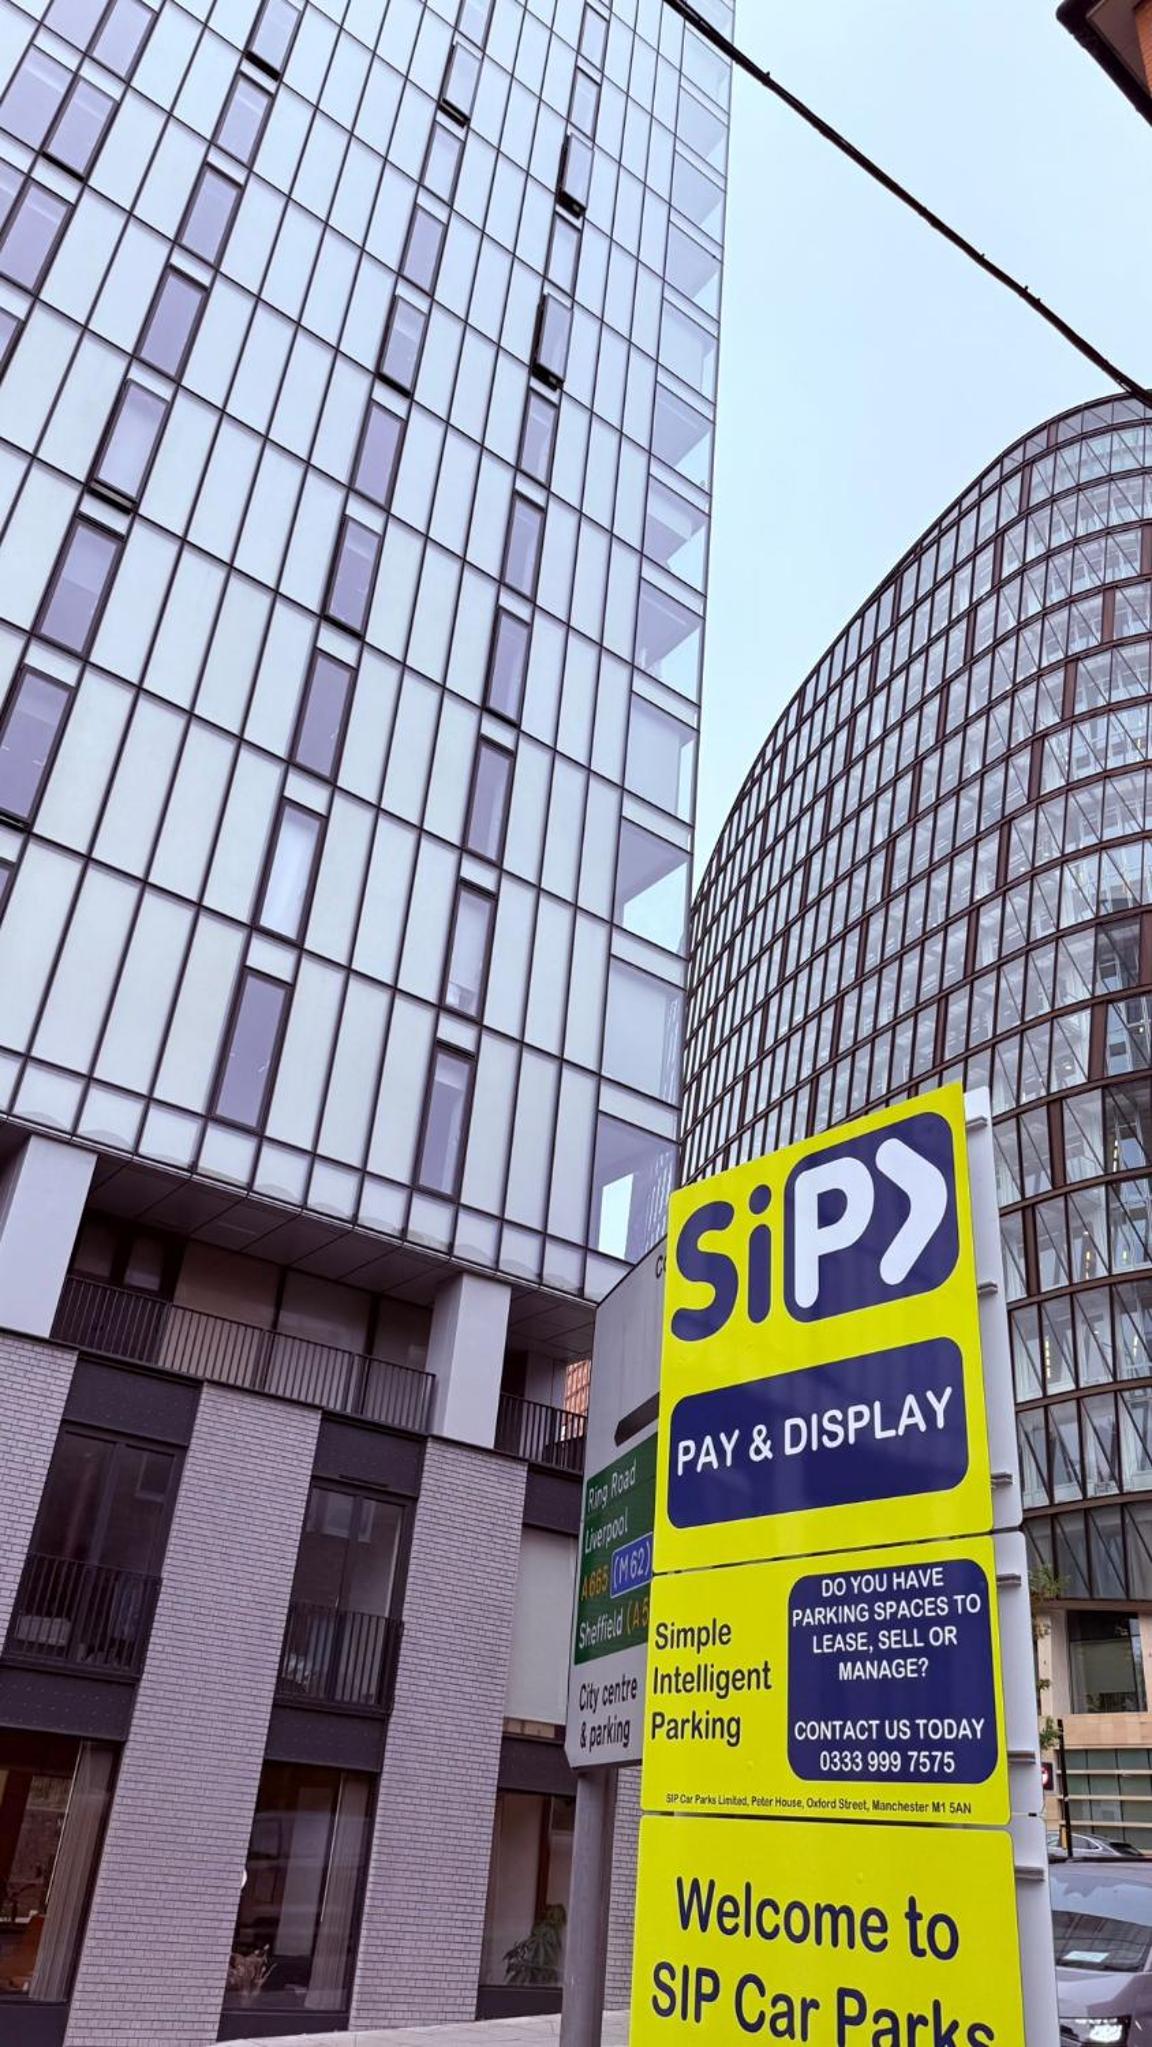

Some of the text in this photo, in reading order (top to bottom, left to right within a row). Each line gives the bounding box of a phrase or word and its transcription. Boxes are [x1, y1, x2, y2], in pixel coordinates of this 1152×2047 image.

[677, 1386, 953, 1477] PAY & DISPLAY
[588, 1457, 636, 1512] Ring Road
[585, 1506, 628, 1553] Liverpool
[613, 1540, 651, 1591] (M62)
[821, 1567, 945, 1598] DO YOU HAVE
[579, 1605, 623, 1648] Sheffield
[792, 1593, 981, 1627] PARKING SPACES TO
[654, 1616, 732, 1655] Simple
[812, 1625, 958, 1654] LEASE, SELL OR
[653, 1660, 772, 1700] Intelligent
[838, 1657, 929, 1681] MANAGE?
[579, 1674, 637, 1714] City centre
[580, 1714, 631, 1752] & parking
[651, 1709, 742, 1748] Parking
[794, 1718, 985, 1741] CONTACT US TODAY
[819, 1750, 955, 1773] 0333 999 7575
[666, 1793, 972, 1814] SIP Car Parks Limited, Peter House, Oxford Street, Manchester M1 5AN
[676, 1876, 960, 1961] Welcome to
[651, 1961, 721, 2024] SIP
[734, 1973, 821, 2043] Car
